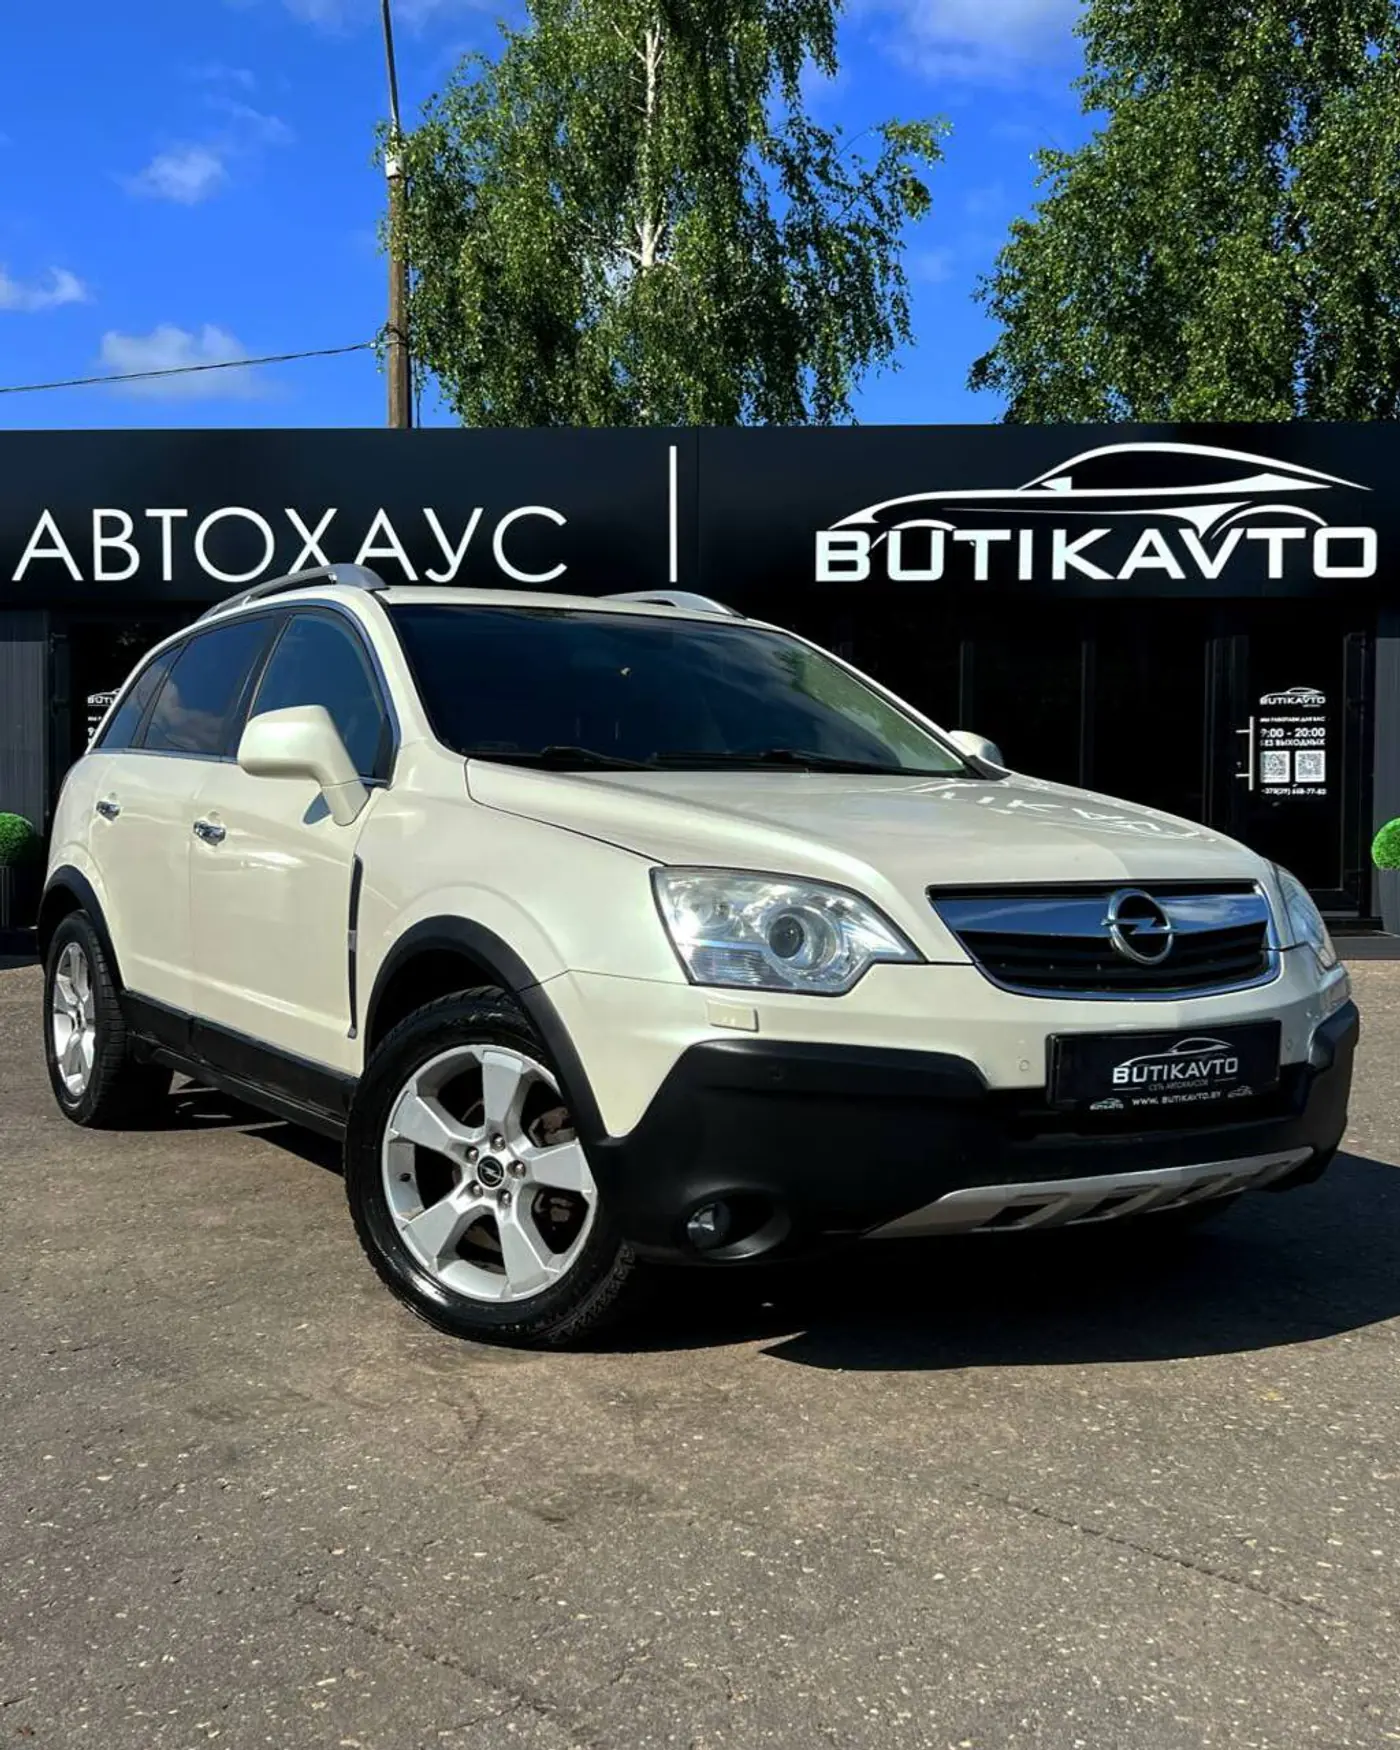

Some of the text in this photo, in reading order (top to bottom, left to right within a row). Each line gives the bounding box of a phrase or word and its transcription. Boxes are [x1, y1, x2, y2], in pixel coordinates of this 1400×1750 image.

[12, 506, 568, 584] АВТОХАУС
[815, 526, 1378, 582] BUTIKAVTO
[1259, 696, 1326, 705] BUTIKAVTO
[1294, 727, 1326, 738] 20:00
[1112, 1057, 1239, 1084] BUTIKAVTO
